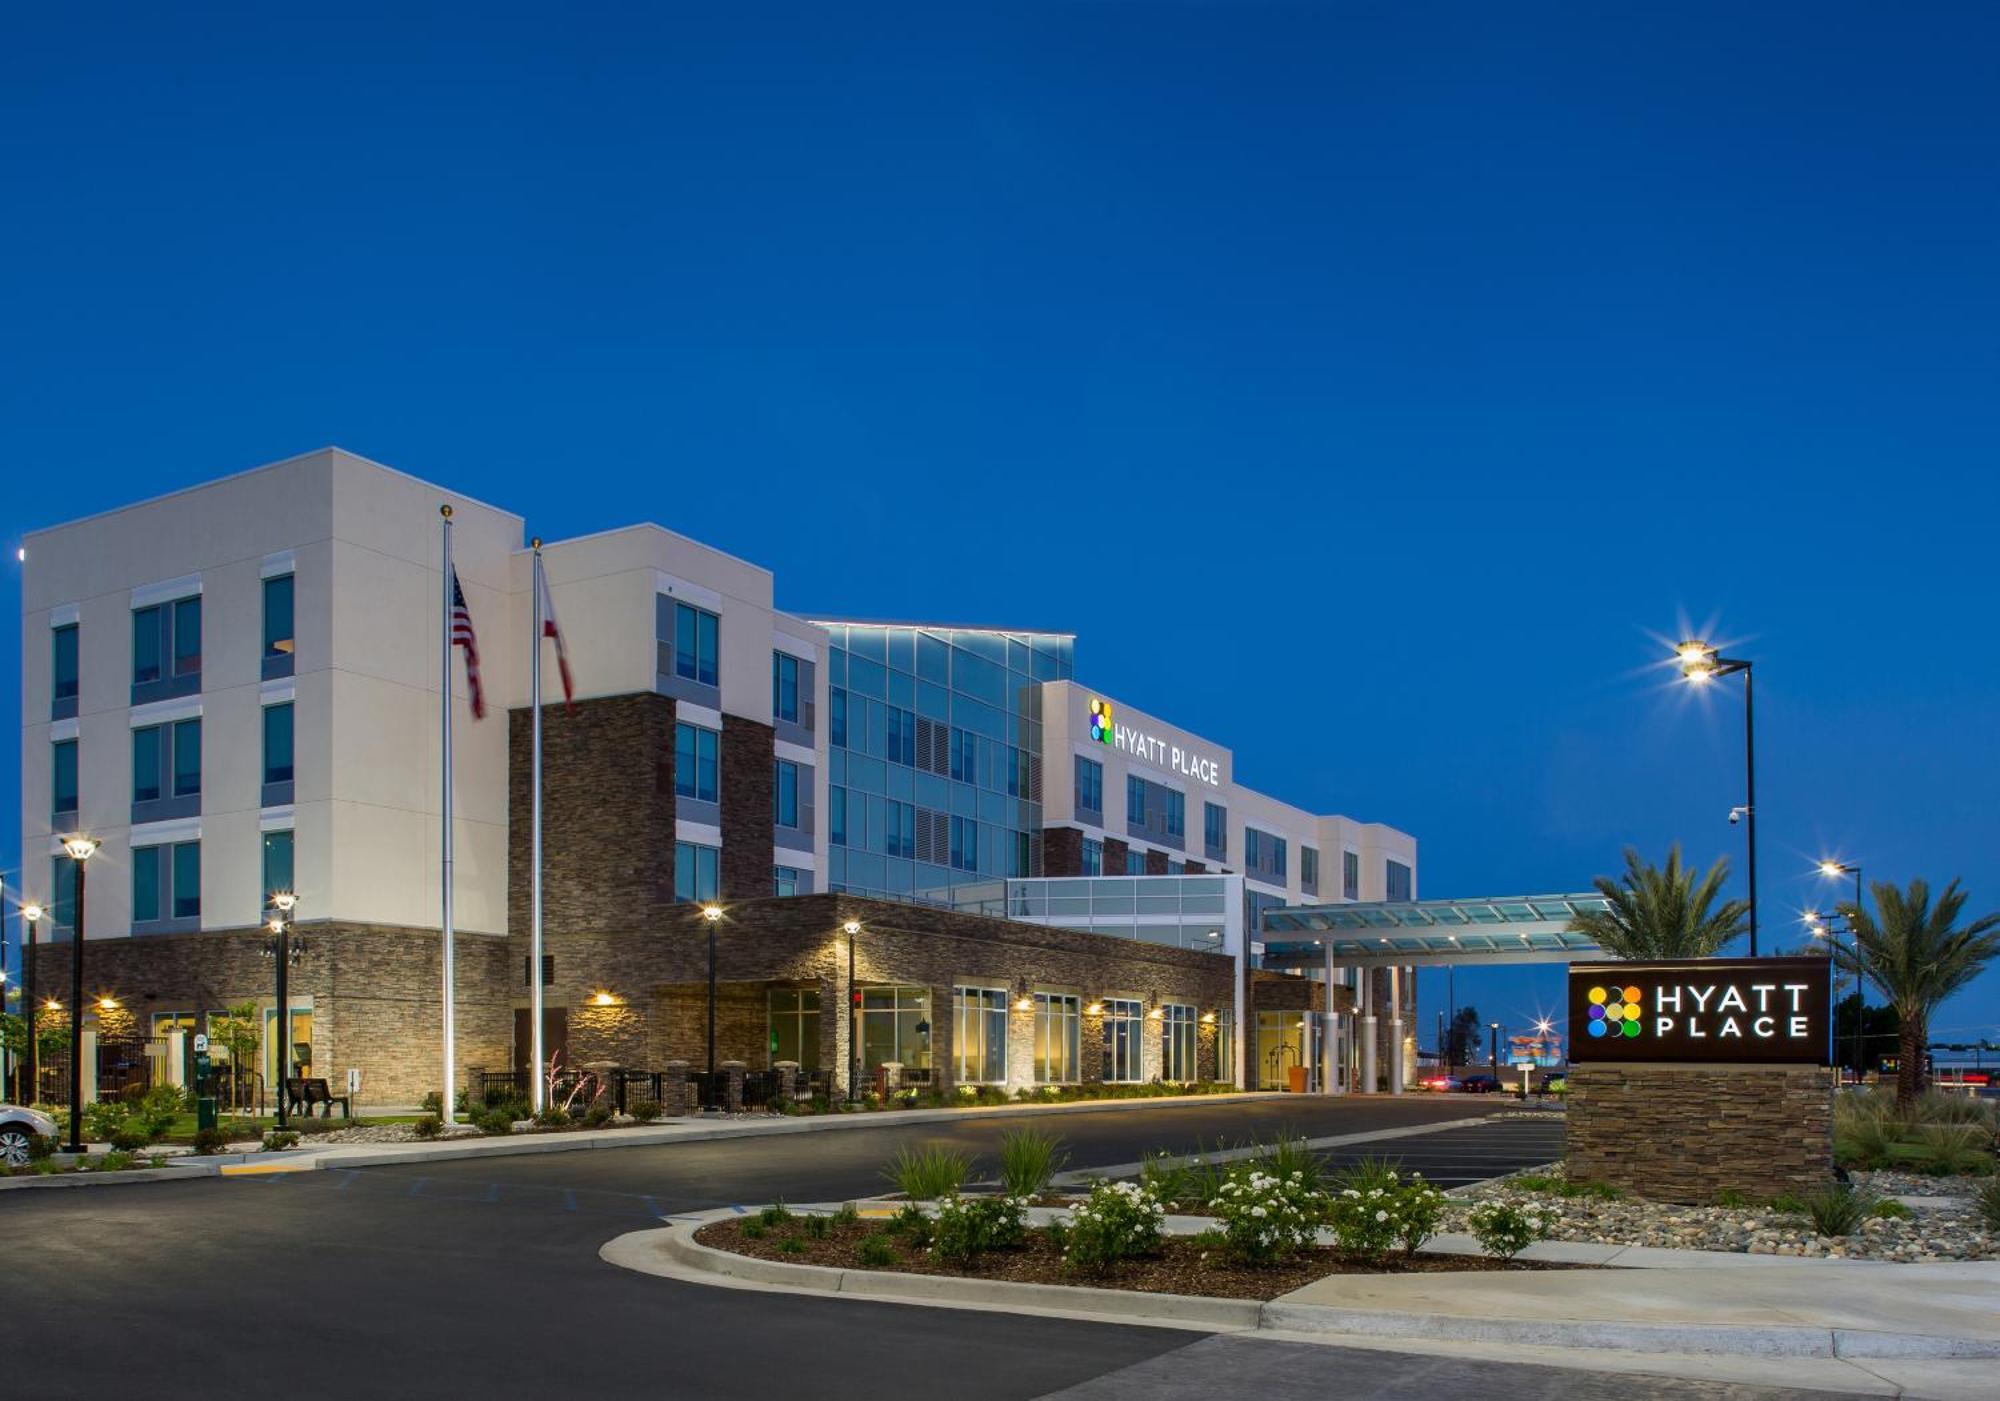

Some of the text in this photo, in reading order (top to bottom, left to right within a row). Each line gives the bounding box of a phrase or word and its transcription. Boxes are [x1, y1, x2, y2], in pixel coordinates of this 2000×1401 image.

[1114, 722, 1219, 787] HYATT PLACE
[1656, 984, 1809, 1013] HYATT
[1656, 1016, 1809, 1038] PLACE
